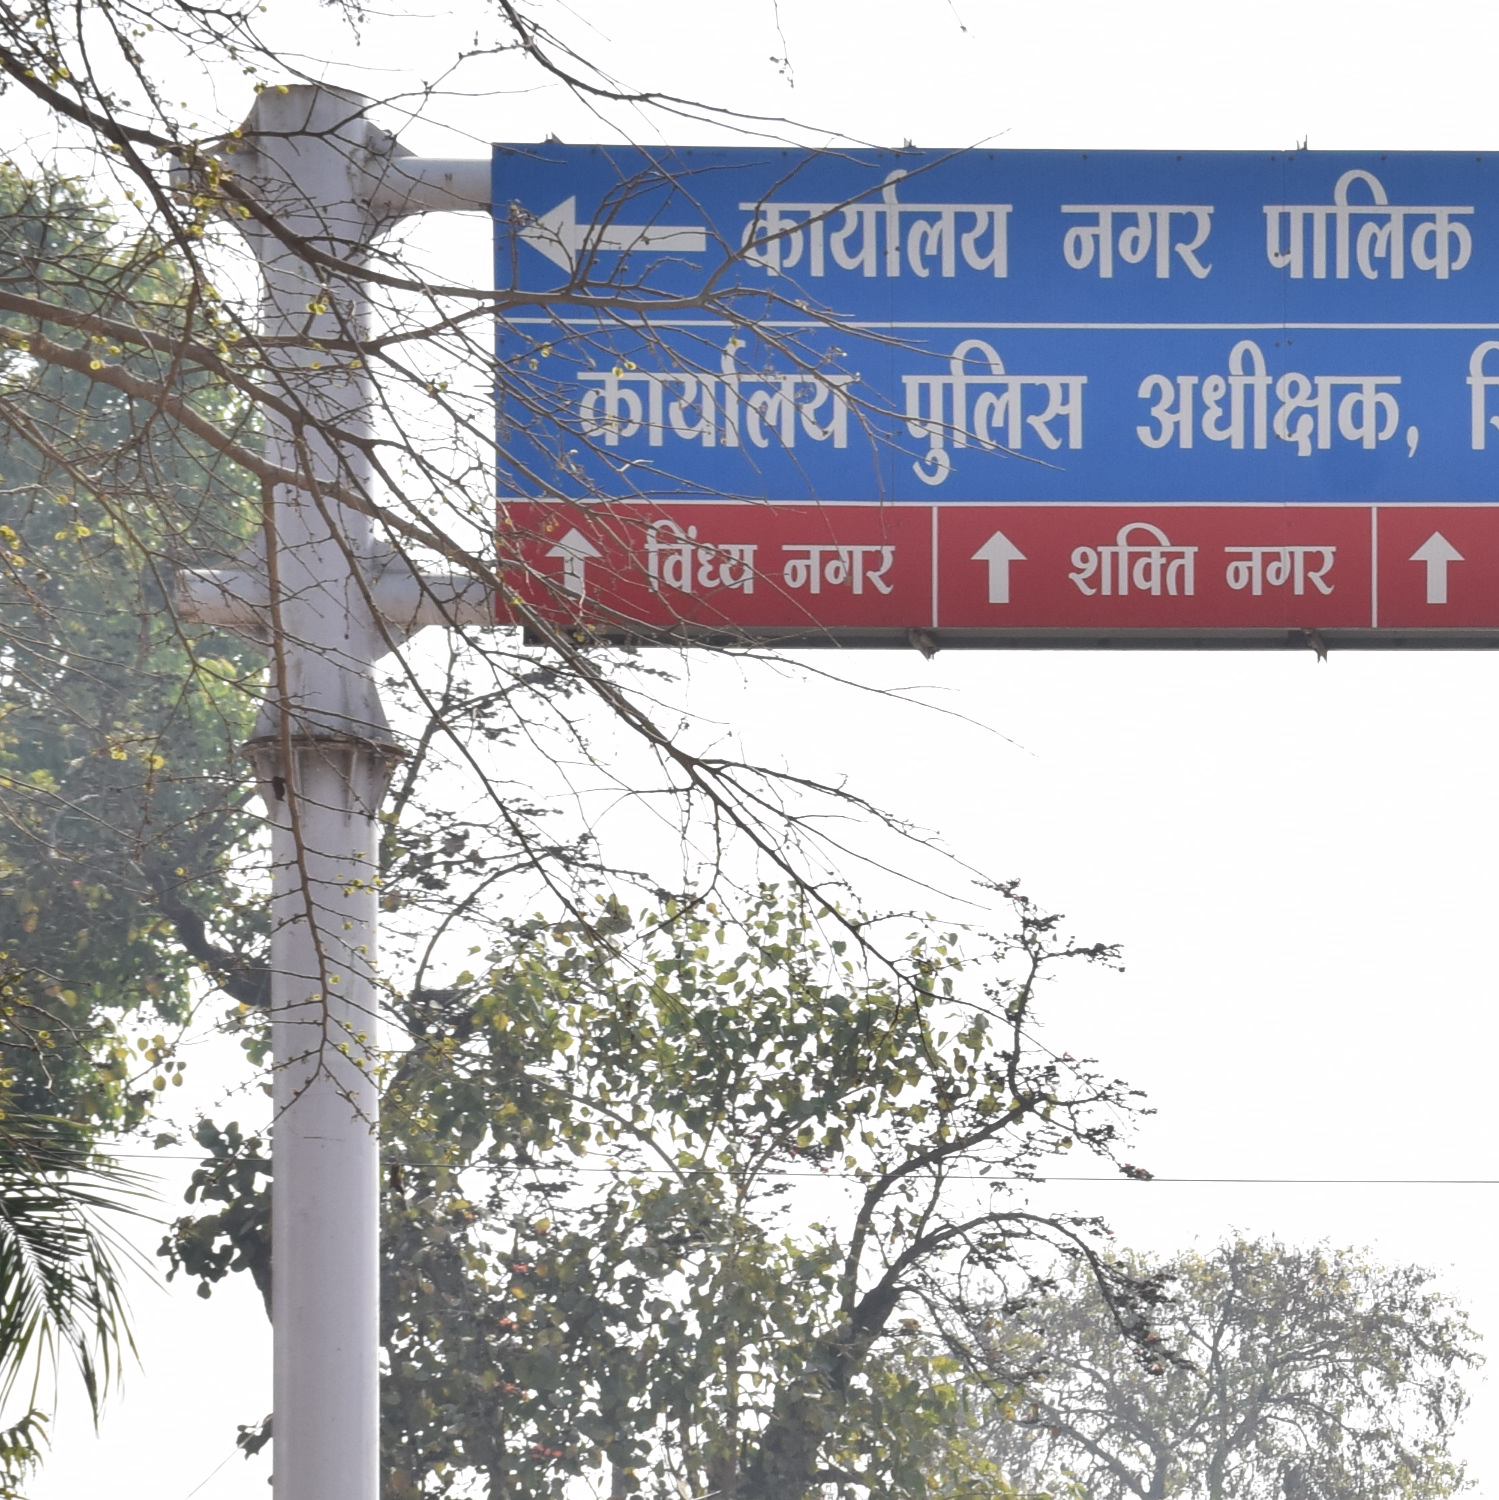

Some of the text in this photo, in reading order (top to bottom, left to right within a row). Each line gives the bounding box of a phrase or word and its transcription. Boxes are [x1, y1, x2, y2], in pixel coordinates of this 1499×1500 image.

[737, 168, 1013, 278] कार्यालय
[1061, 204, 1214, 278] नगर
[1263, 168, 1474, 279] पालिक
[577, 338, 860, 450] कार्यालय
[902, 338, 1088, 486] पुलिस
[1136, 338, 1420, 458] अधीक्षक,
[782, 544, 895, 596] नगर
[1069, 521, 1336, 597] शक्ति नगर
